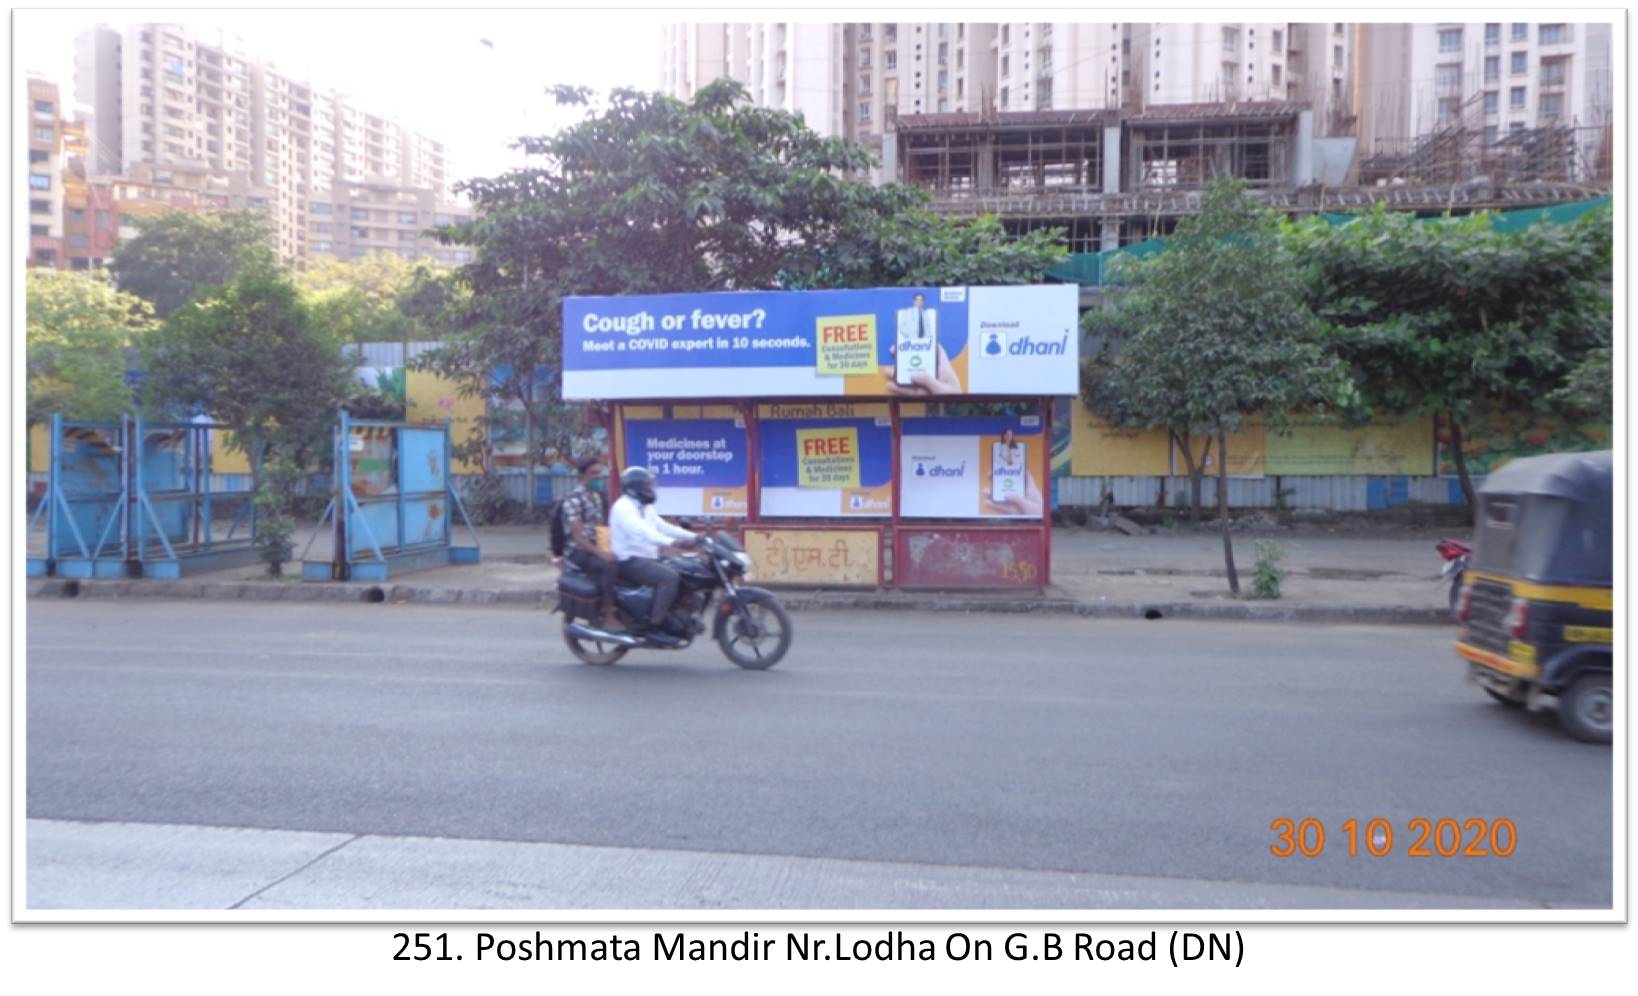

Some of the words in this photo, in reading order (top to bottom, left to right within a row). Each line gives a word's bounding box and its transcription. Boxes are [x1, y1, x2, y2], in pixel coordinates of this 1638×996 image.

[583, 311, 655, 335] Cough
[661, 314, 686, 331] or
[691, 308, 767, 330] fever?
[980, 320, 1020, 329] Download
[823, 323, 868, 343] FREE
[583, 339, 615, 351] Meet
[617, 341, 626, 350] a
[628, 337, 668, 350] COVID
[672, 337, 714, 351] expert
[716, 337, 728, 349] in
[733, 336, 749, 348] 10
[752, 336, 811, 349] seconds.
[899, 336, 933, 352] dhani
[1008, 328, 1069, 356] dhani
[646, 437, 710, 450] Medicines
[712, 438, 727, 449] at
[804, 436, 850, 457] FREE
[647, 451, 675, 464] your
[676, 449, 734, 463] doorstep
[662, 463, 671, 475] 1
[673, 463, 705, 476] hour.
[929, 460, 967, 477] dhani
[994, 466, 1023, 476] dhani
